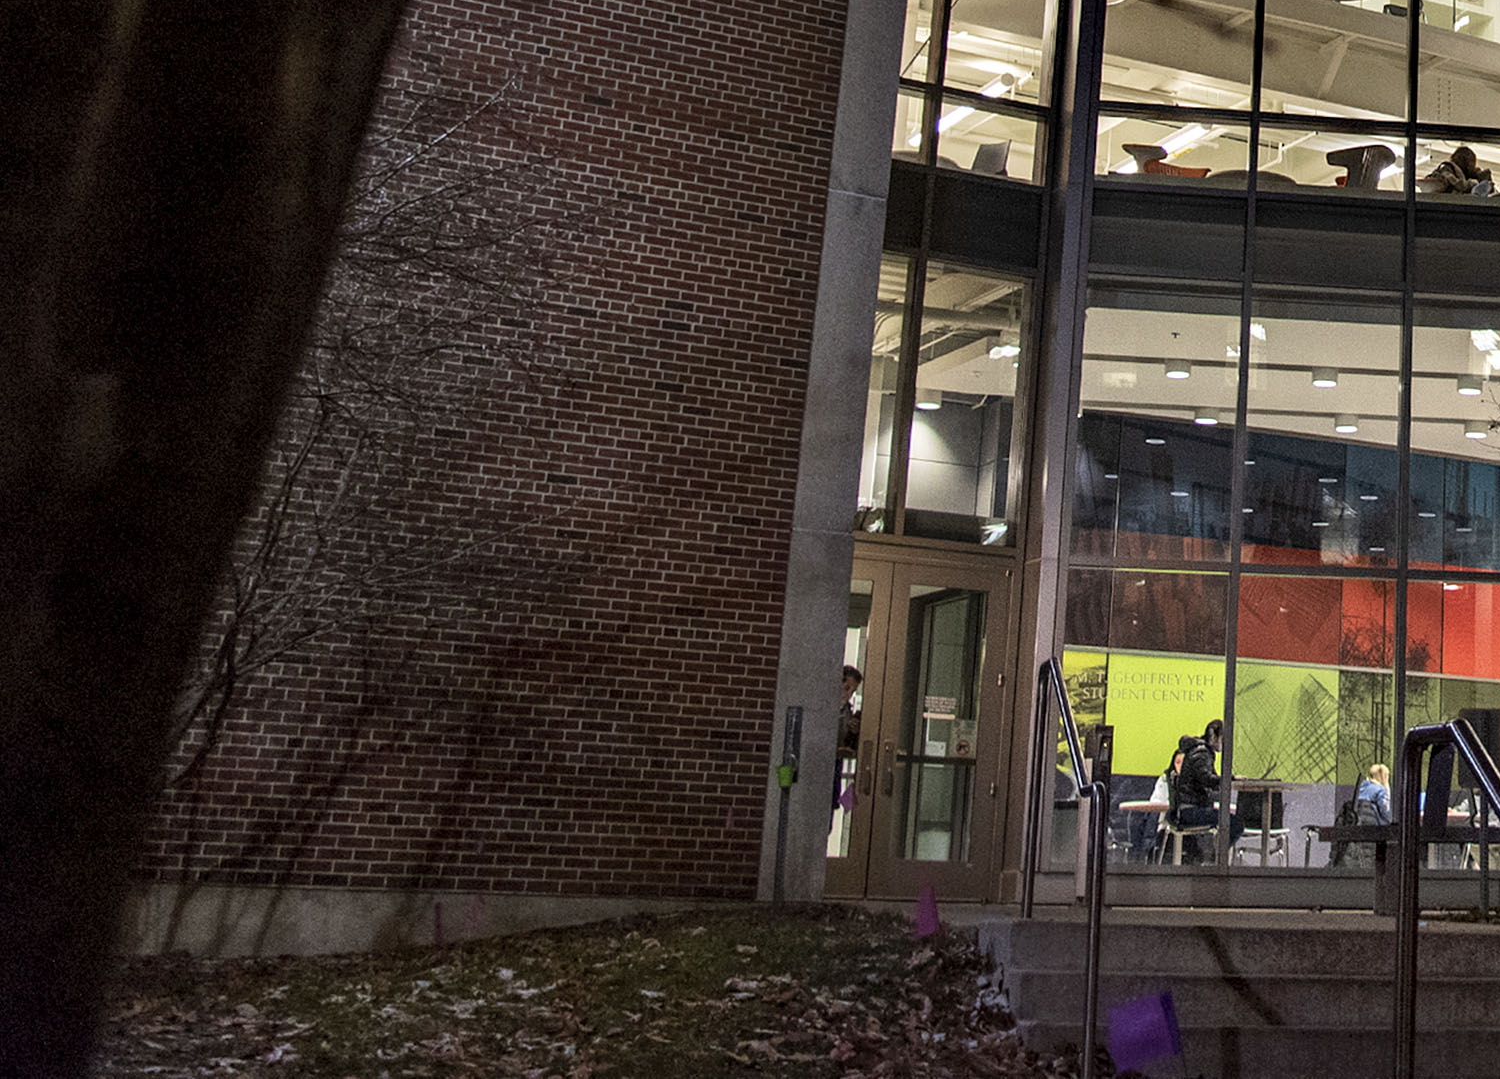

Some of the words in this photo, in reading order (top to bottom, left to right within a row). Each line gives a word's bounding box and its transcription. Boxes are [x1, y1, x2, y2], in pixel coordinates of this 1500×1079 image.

[1074, 673, 1091, 683] M.
[1113, 672, 1183, 685] GEOFFREY
[1186, 674, 1215, 687] YEH
[1082, 687, 1148, 700] STUDENT
[1151, 689, 1205, 702] CENTER
